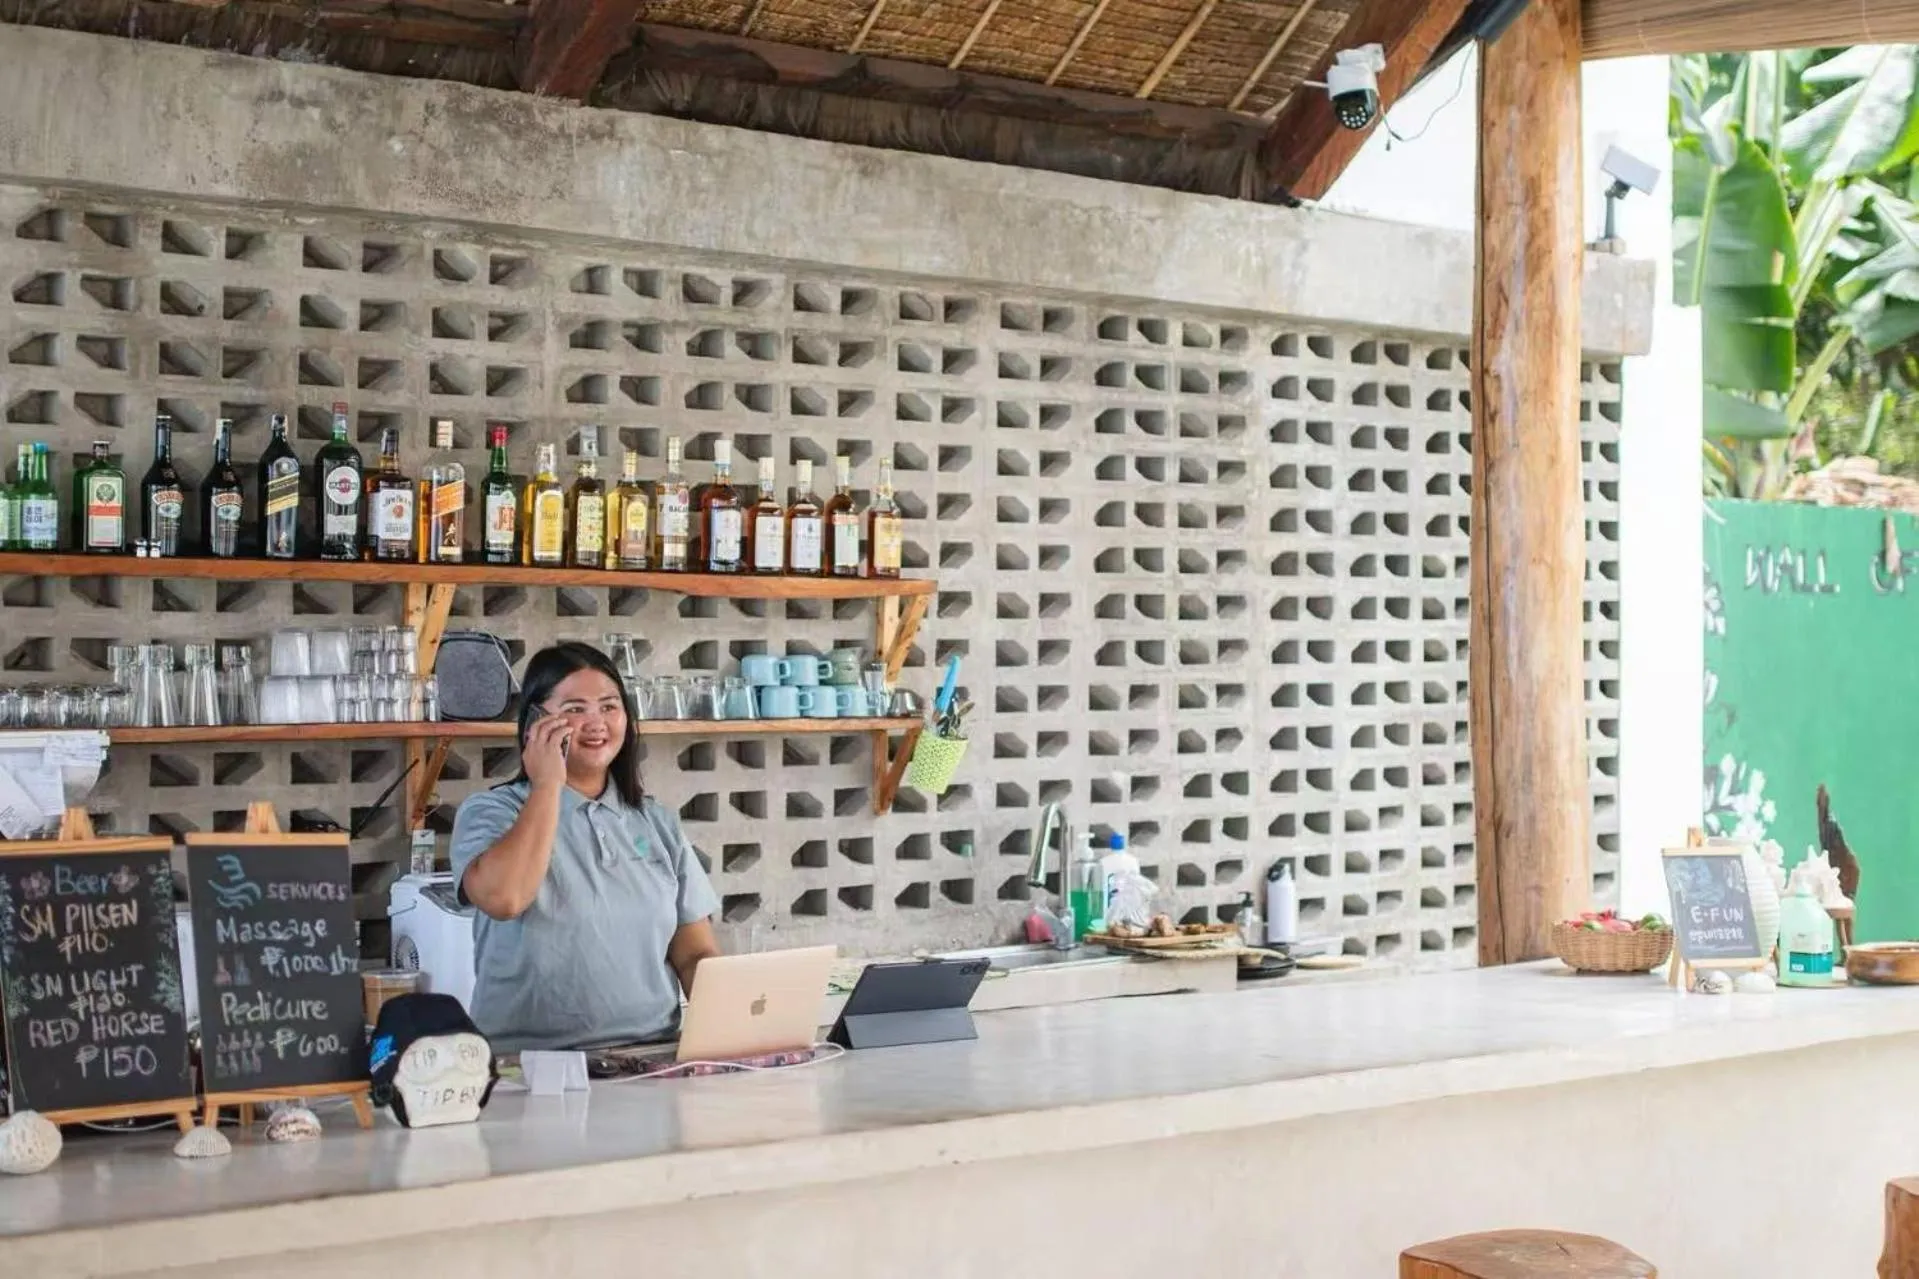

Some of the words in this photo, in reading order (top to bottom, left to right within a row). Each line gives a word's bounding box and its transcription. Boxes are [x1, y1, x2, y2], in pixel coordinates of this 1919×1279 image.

[1745, 544, 1840, 594] WALL
[54, 862, 113, 896] Beer
[18, 903, 57, 943] SM
[65, 899, 139, 934] PILSEN
[216, 916, 328, 948] Massage
[30, 972, 64, 999] SM
[220, 990, 329, 1026] Pedicure
[29, 1018, 80, 1048] RED
[91, 1011, 165, 1042] HORSE
